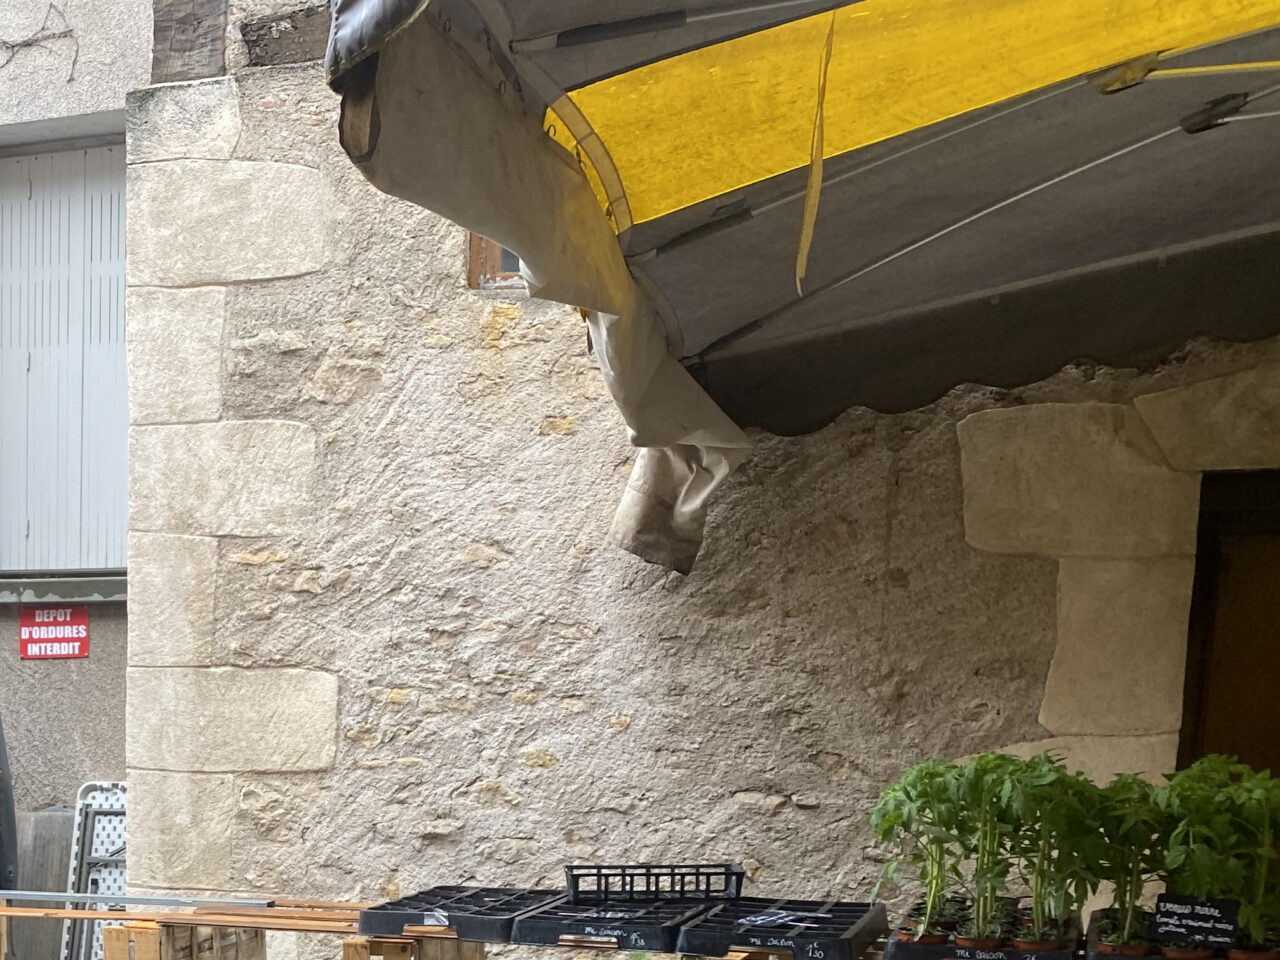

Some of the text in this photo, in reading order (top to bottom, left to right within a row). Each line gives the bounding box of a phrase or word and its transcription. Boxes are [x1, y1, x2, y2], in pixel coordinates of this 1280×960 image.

[35, 609, 72, 622] DEPOT
[21, 625, 87, 639] D'ORDURES
[27, 642, 80, 656] INTERDIT
